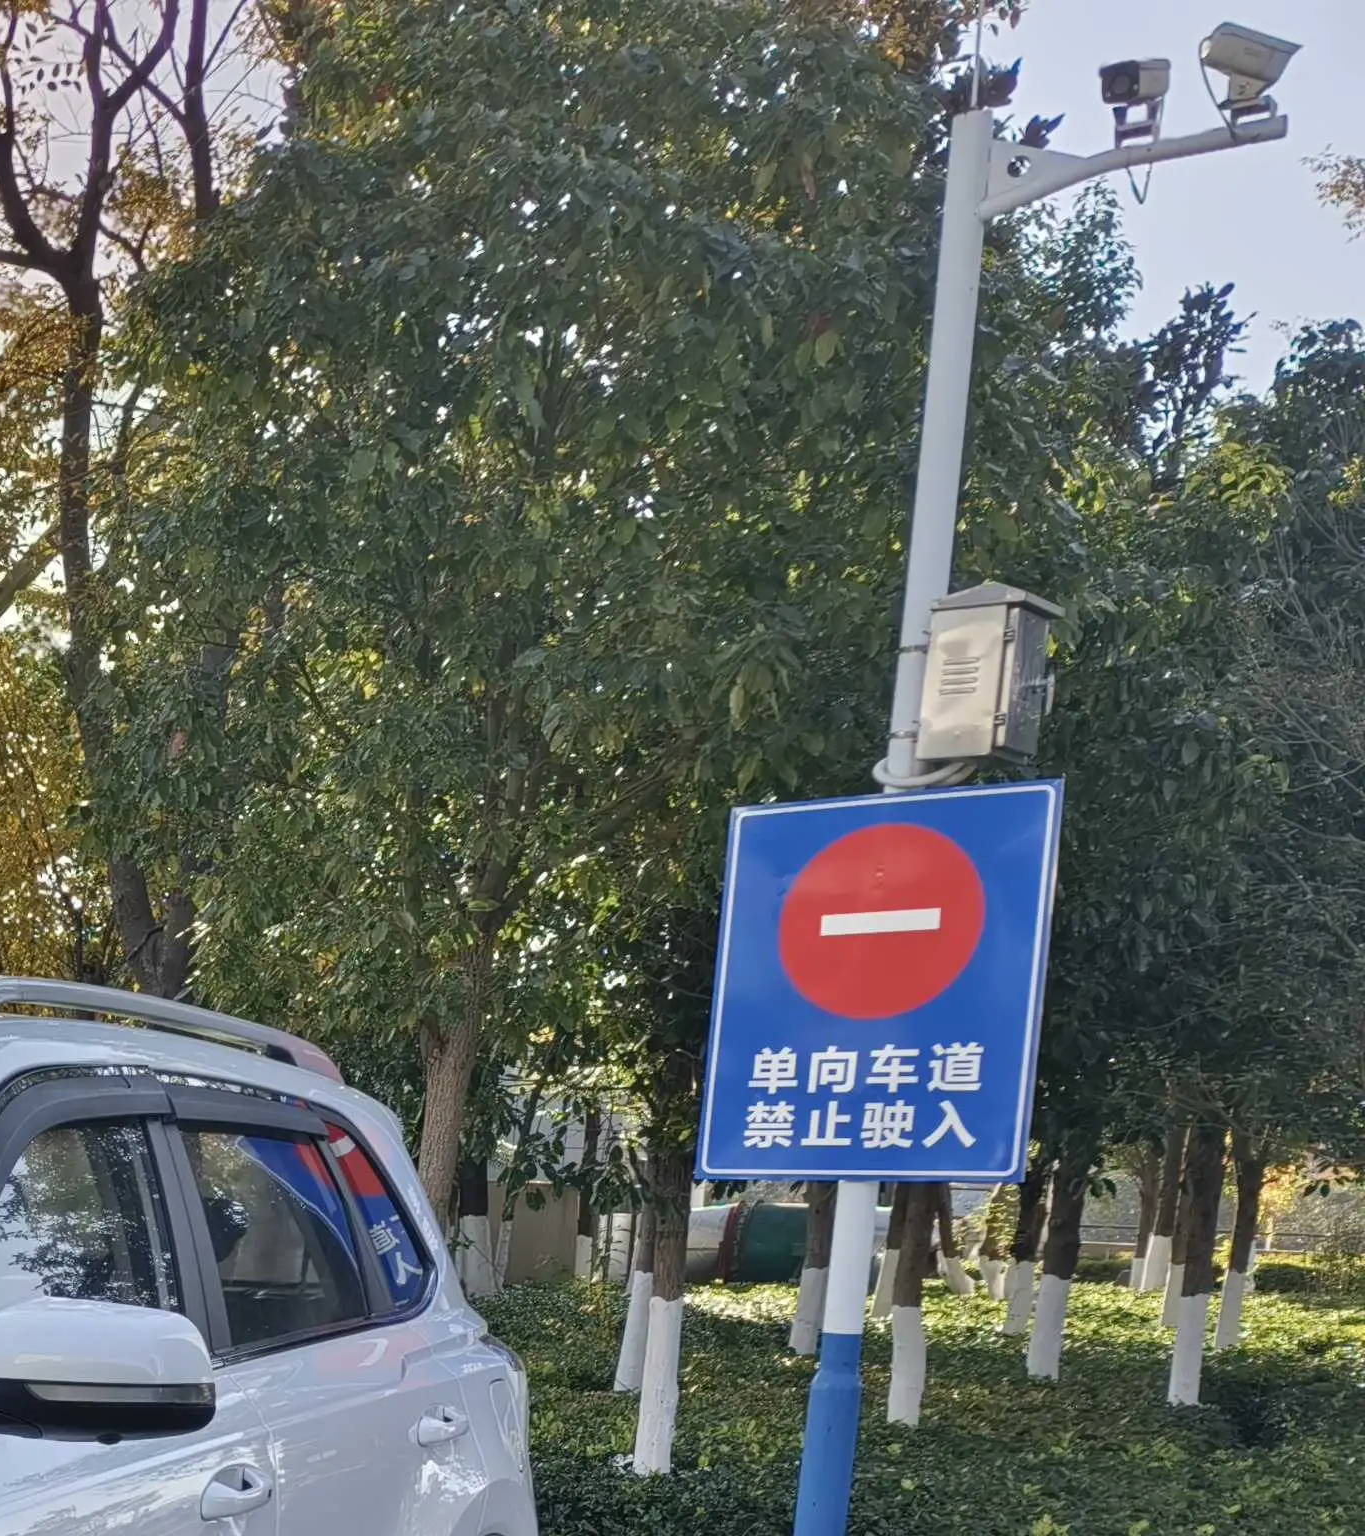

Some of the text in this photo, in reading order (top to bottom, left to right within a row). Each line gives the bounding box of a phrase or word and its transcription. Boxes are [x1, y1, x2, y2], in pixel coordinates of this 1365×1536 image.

[748, 1041, 985, 1095] 单向车道
[743, 1099, 977, 1149] 禁止驶入
